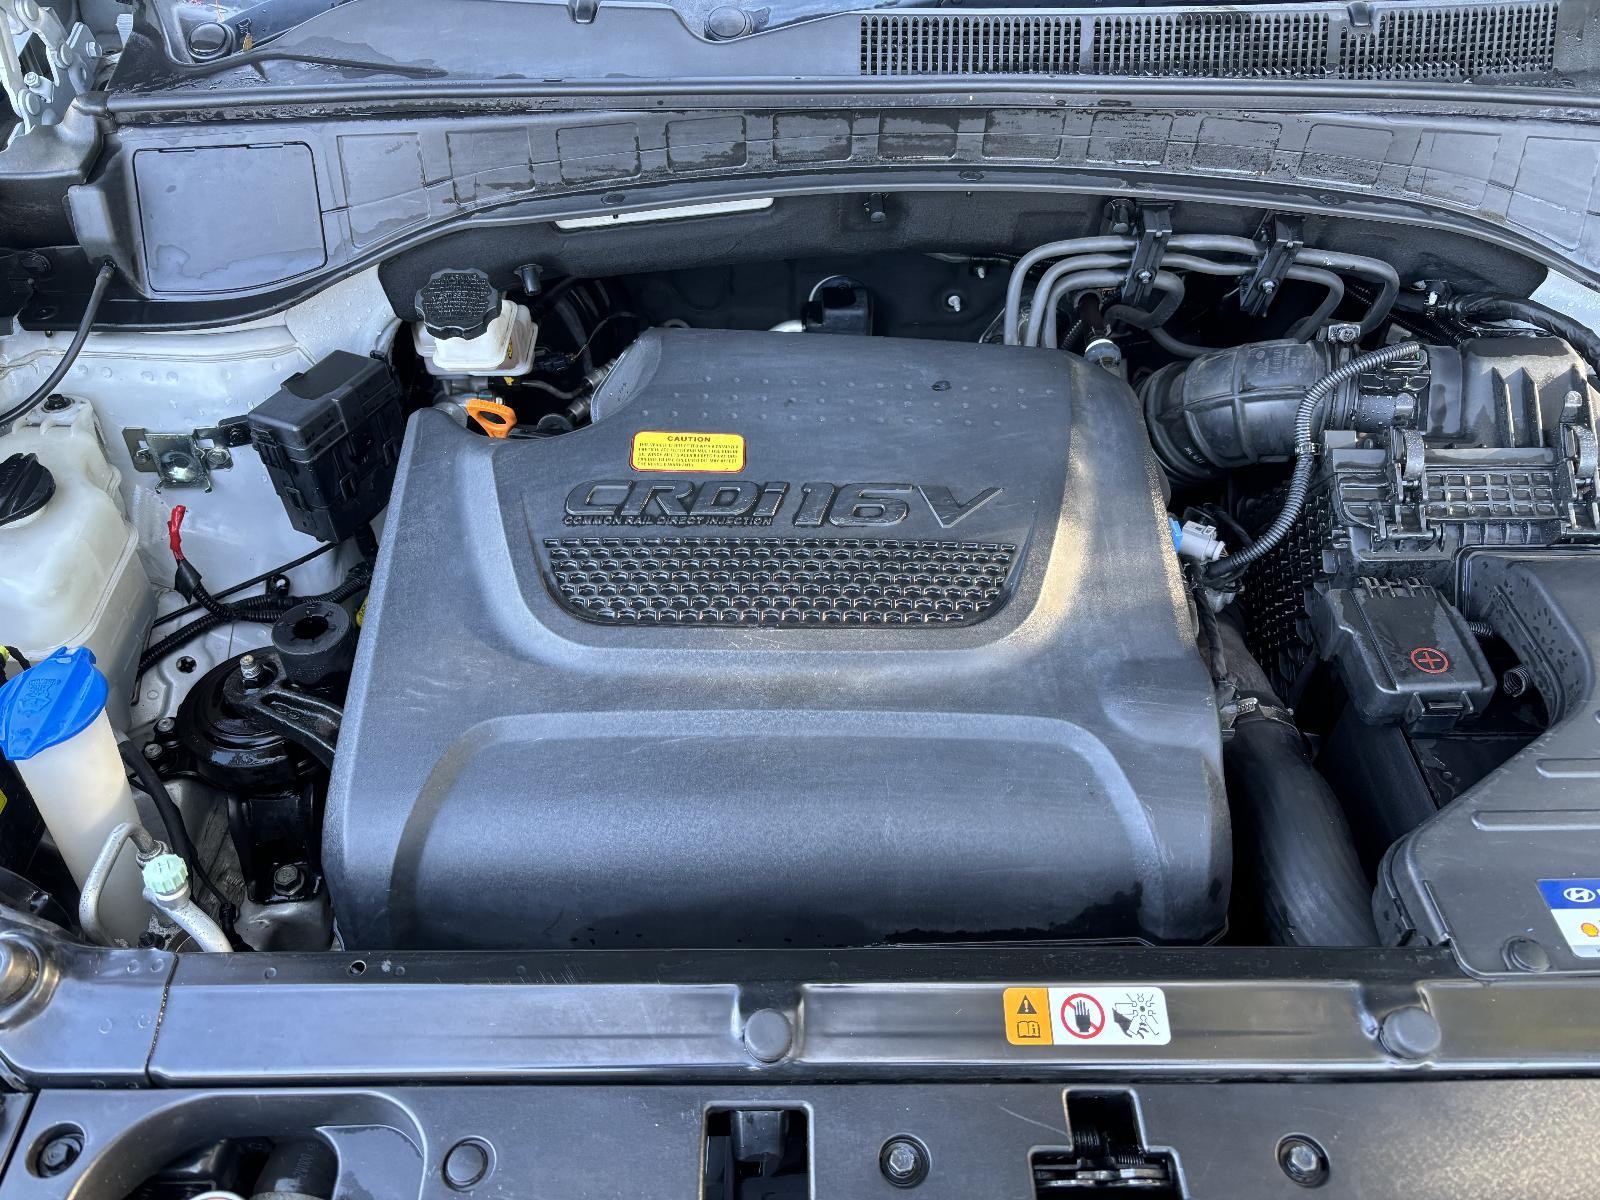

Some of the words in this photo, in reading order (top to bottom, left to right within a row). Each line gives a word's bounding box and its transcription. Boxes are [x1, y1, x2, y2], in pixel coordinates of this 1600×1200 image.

[566, 480, 790, 517] CRDi
[564, 516, 622, 526] COMMON
[624, 516, 654, 526] RAIL
[657, 516, 704, 526] DIRECT
[705, 516, 773, 527] INJECTION
